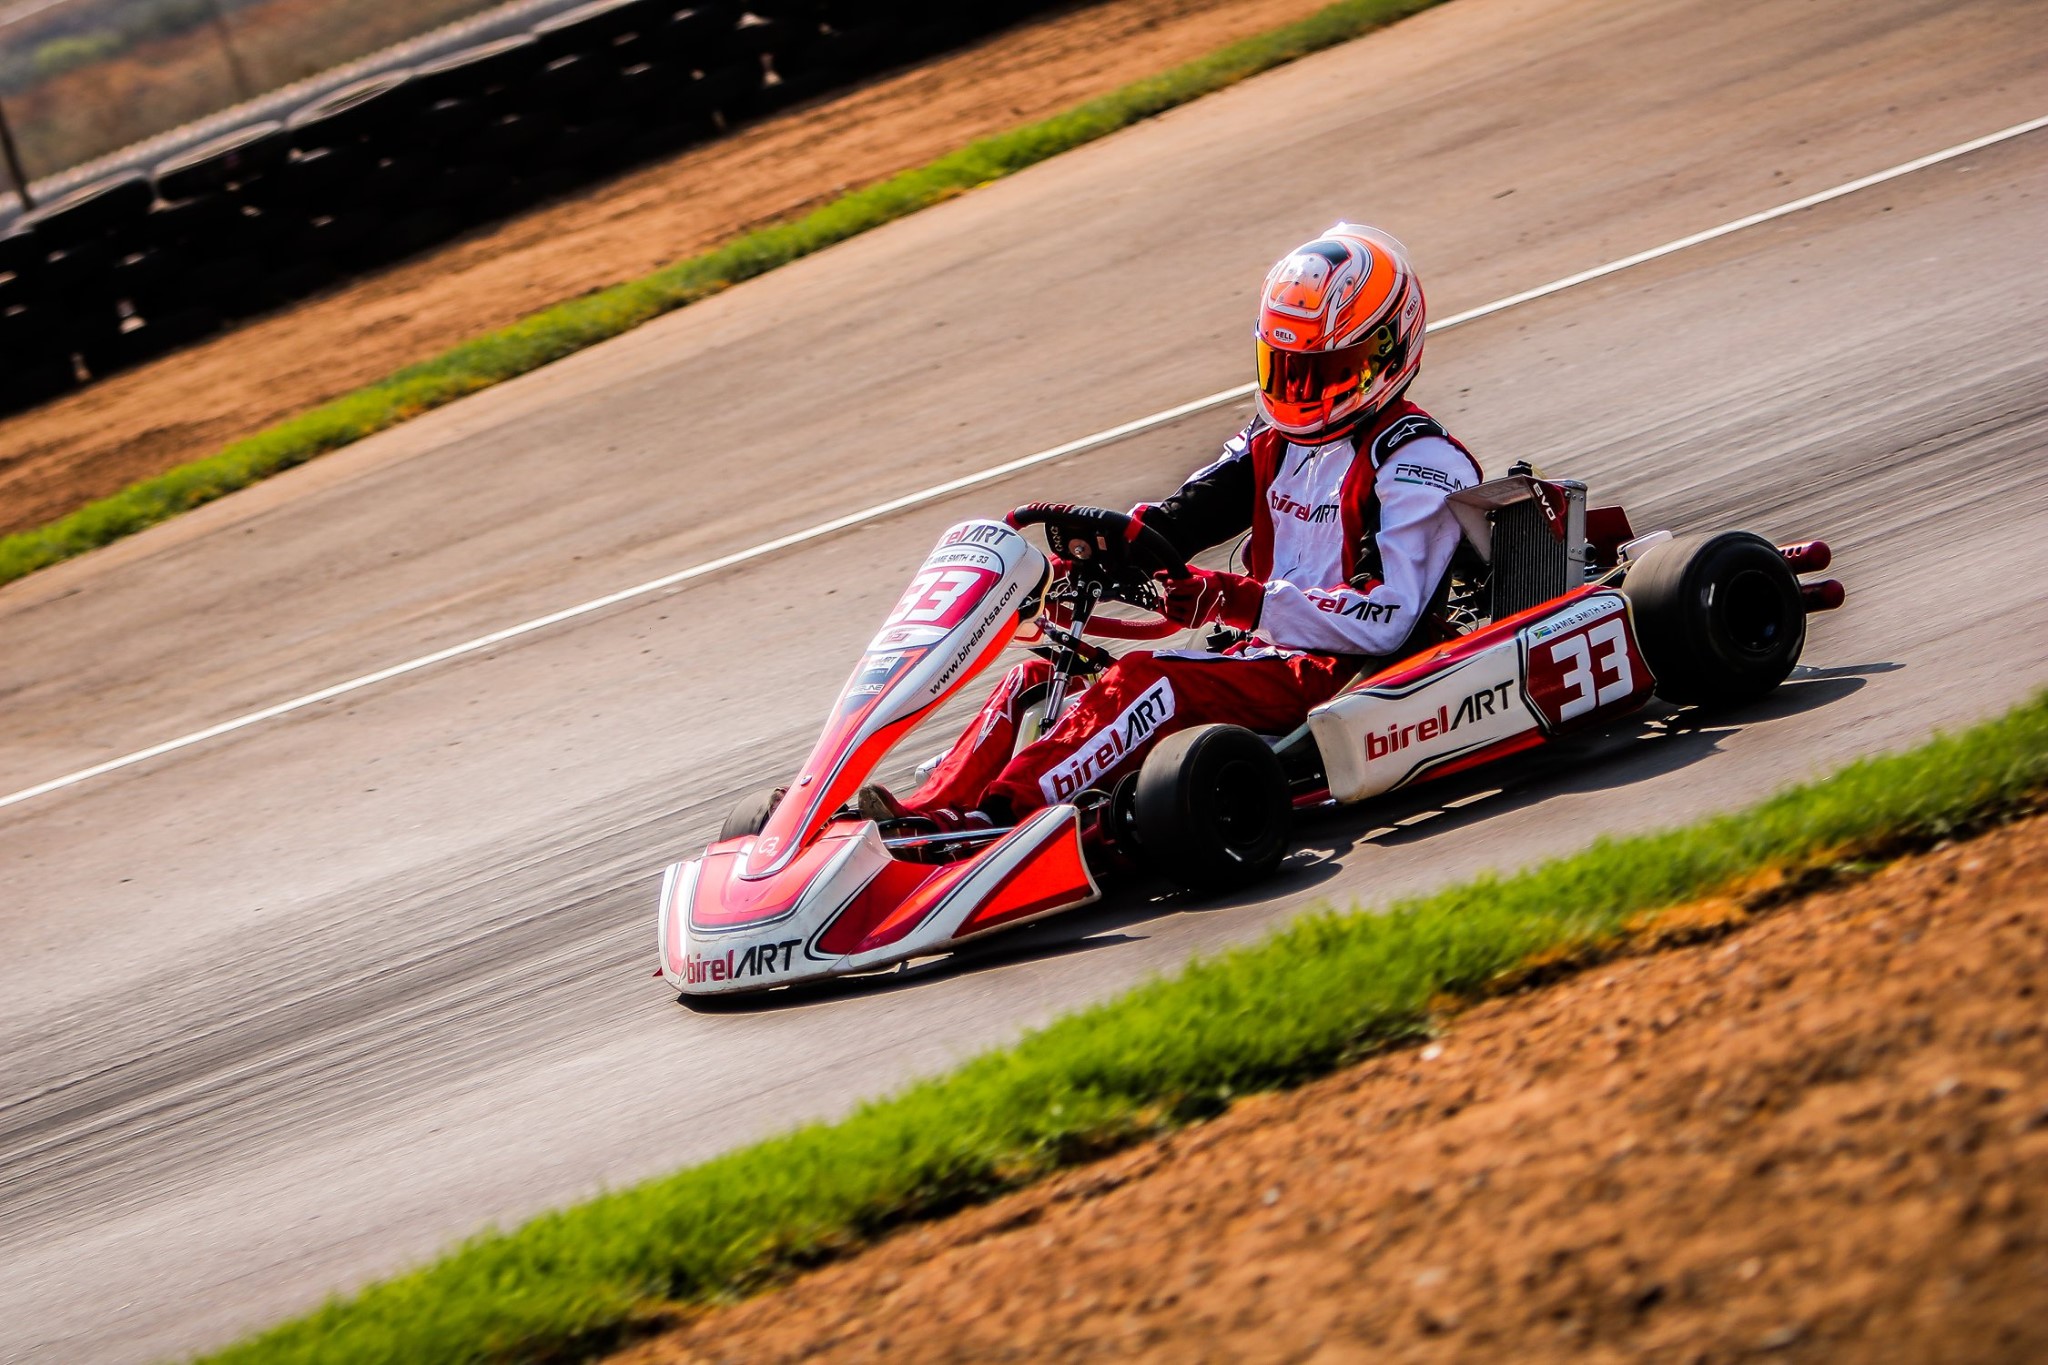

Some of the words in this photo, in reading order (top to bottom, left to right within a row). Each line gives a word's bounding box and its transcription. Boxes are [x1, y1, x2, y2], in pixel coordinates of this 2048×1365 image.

[1275, 330, 1294, 341] BELL
[1395, 463, 1467, 491] FREELIN
[1271, 490, 1340, 523] birelART
[1533, 482, 1556, 521] EVO
[976, 555, 990, 564] 33
[1306, 594, 1402, 624] relART
[1551, 617, 1576, 633] JAMIE
[1574, 606, 1601, 621] SMITH
[929, 581, 1019, 695] www.birelartsa.com
[1549, 617, 1634, 723] 33
[1364, 679, 1515, 763] birelART
[1051, 686, 1167, 801] birelART
[686, 938, 803, 984] birelART
